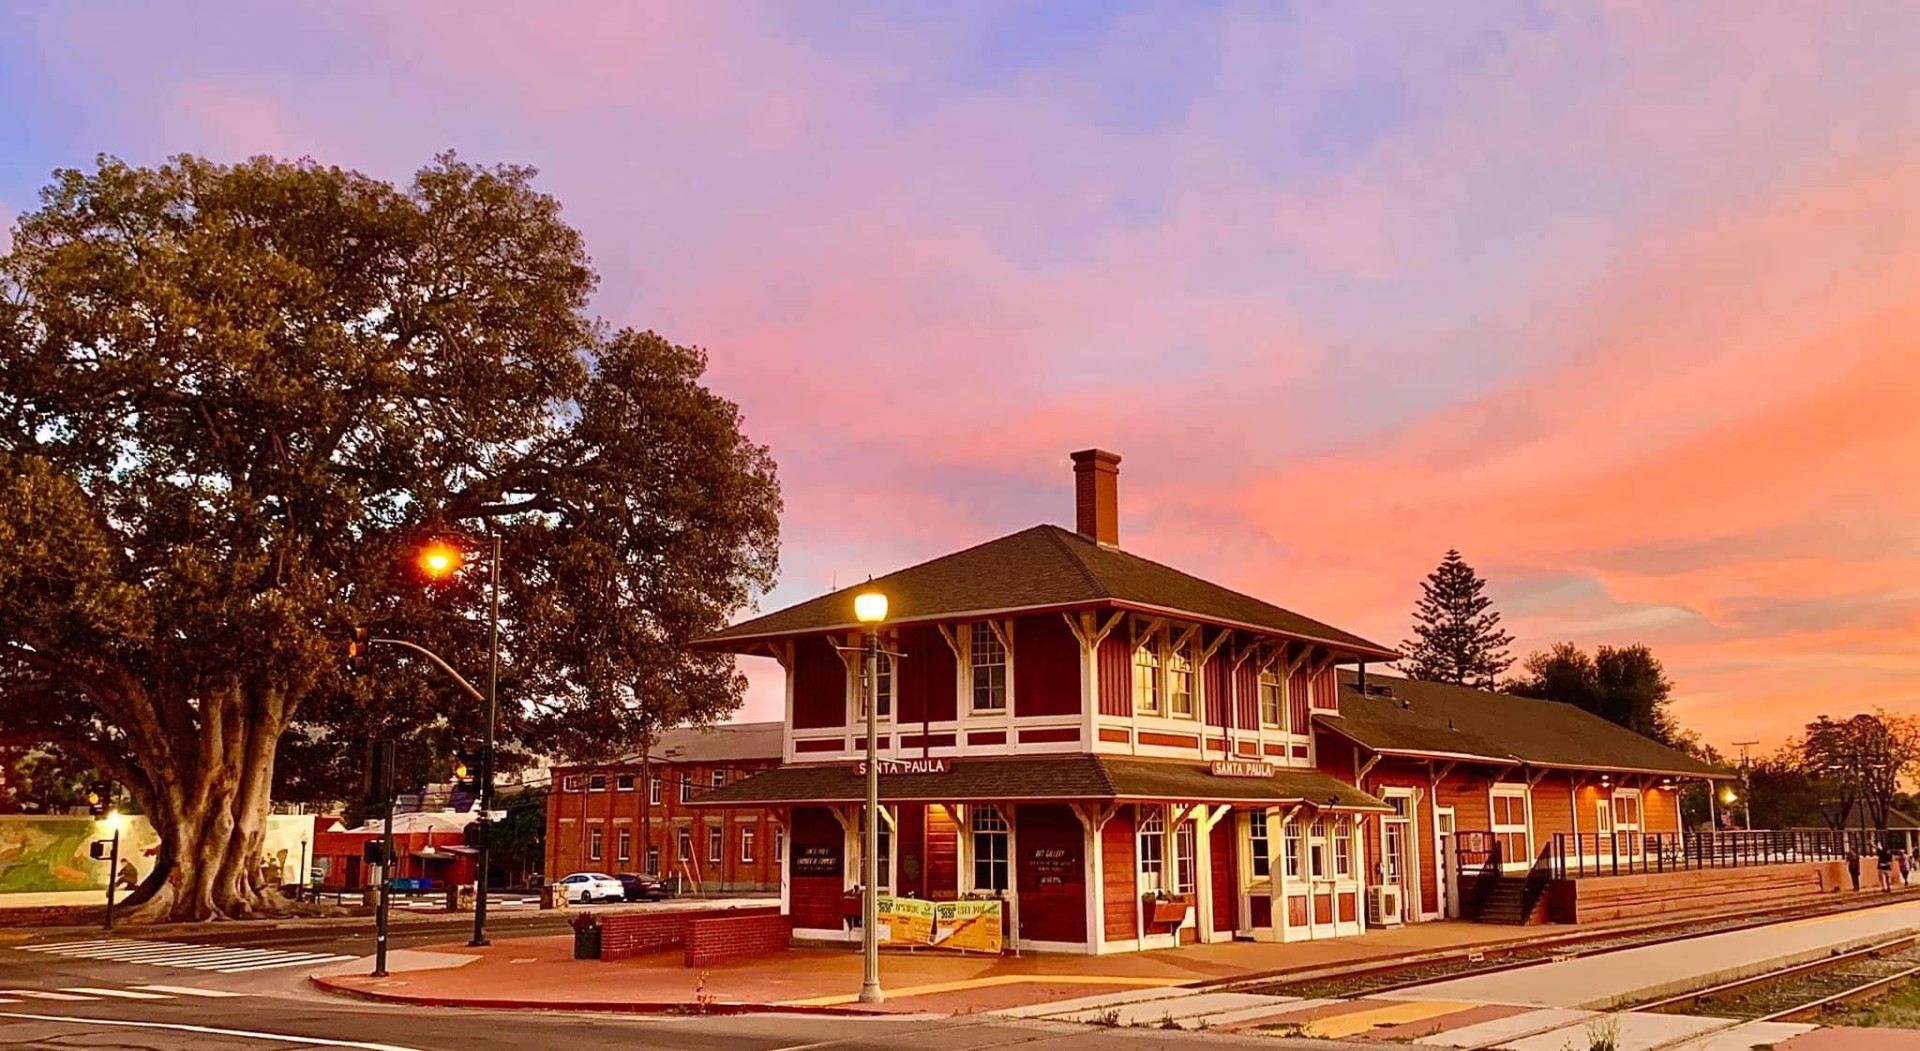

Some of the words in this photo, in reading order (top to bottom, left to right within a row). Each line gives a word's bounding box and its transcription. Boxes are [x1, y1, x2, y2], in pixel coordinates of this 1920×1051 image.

[858, 762, 898, 775] SNTA
[904, 760, 945, 773] PAULA
[1216, 762, 1243, 775] SANTA
[1246, 763, 1272, 777] PAULA
